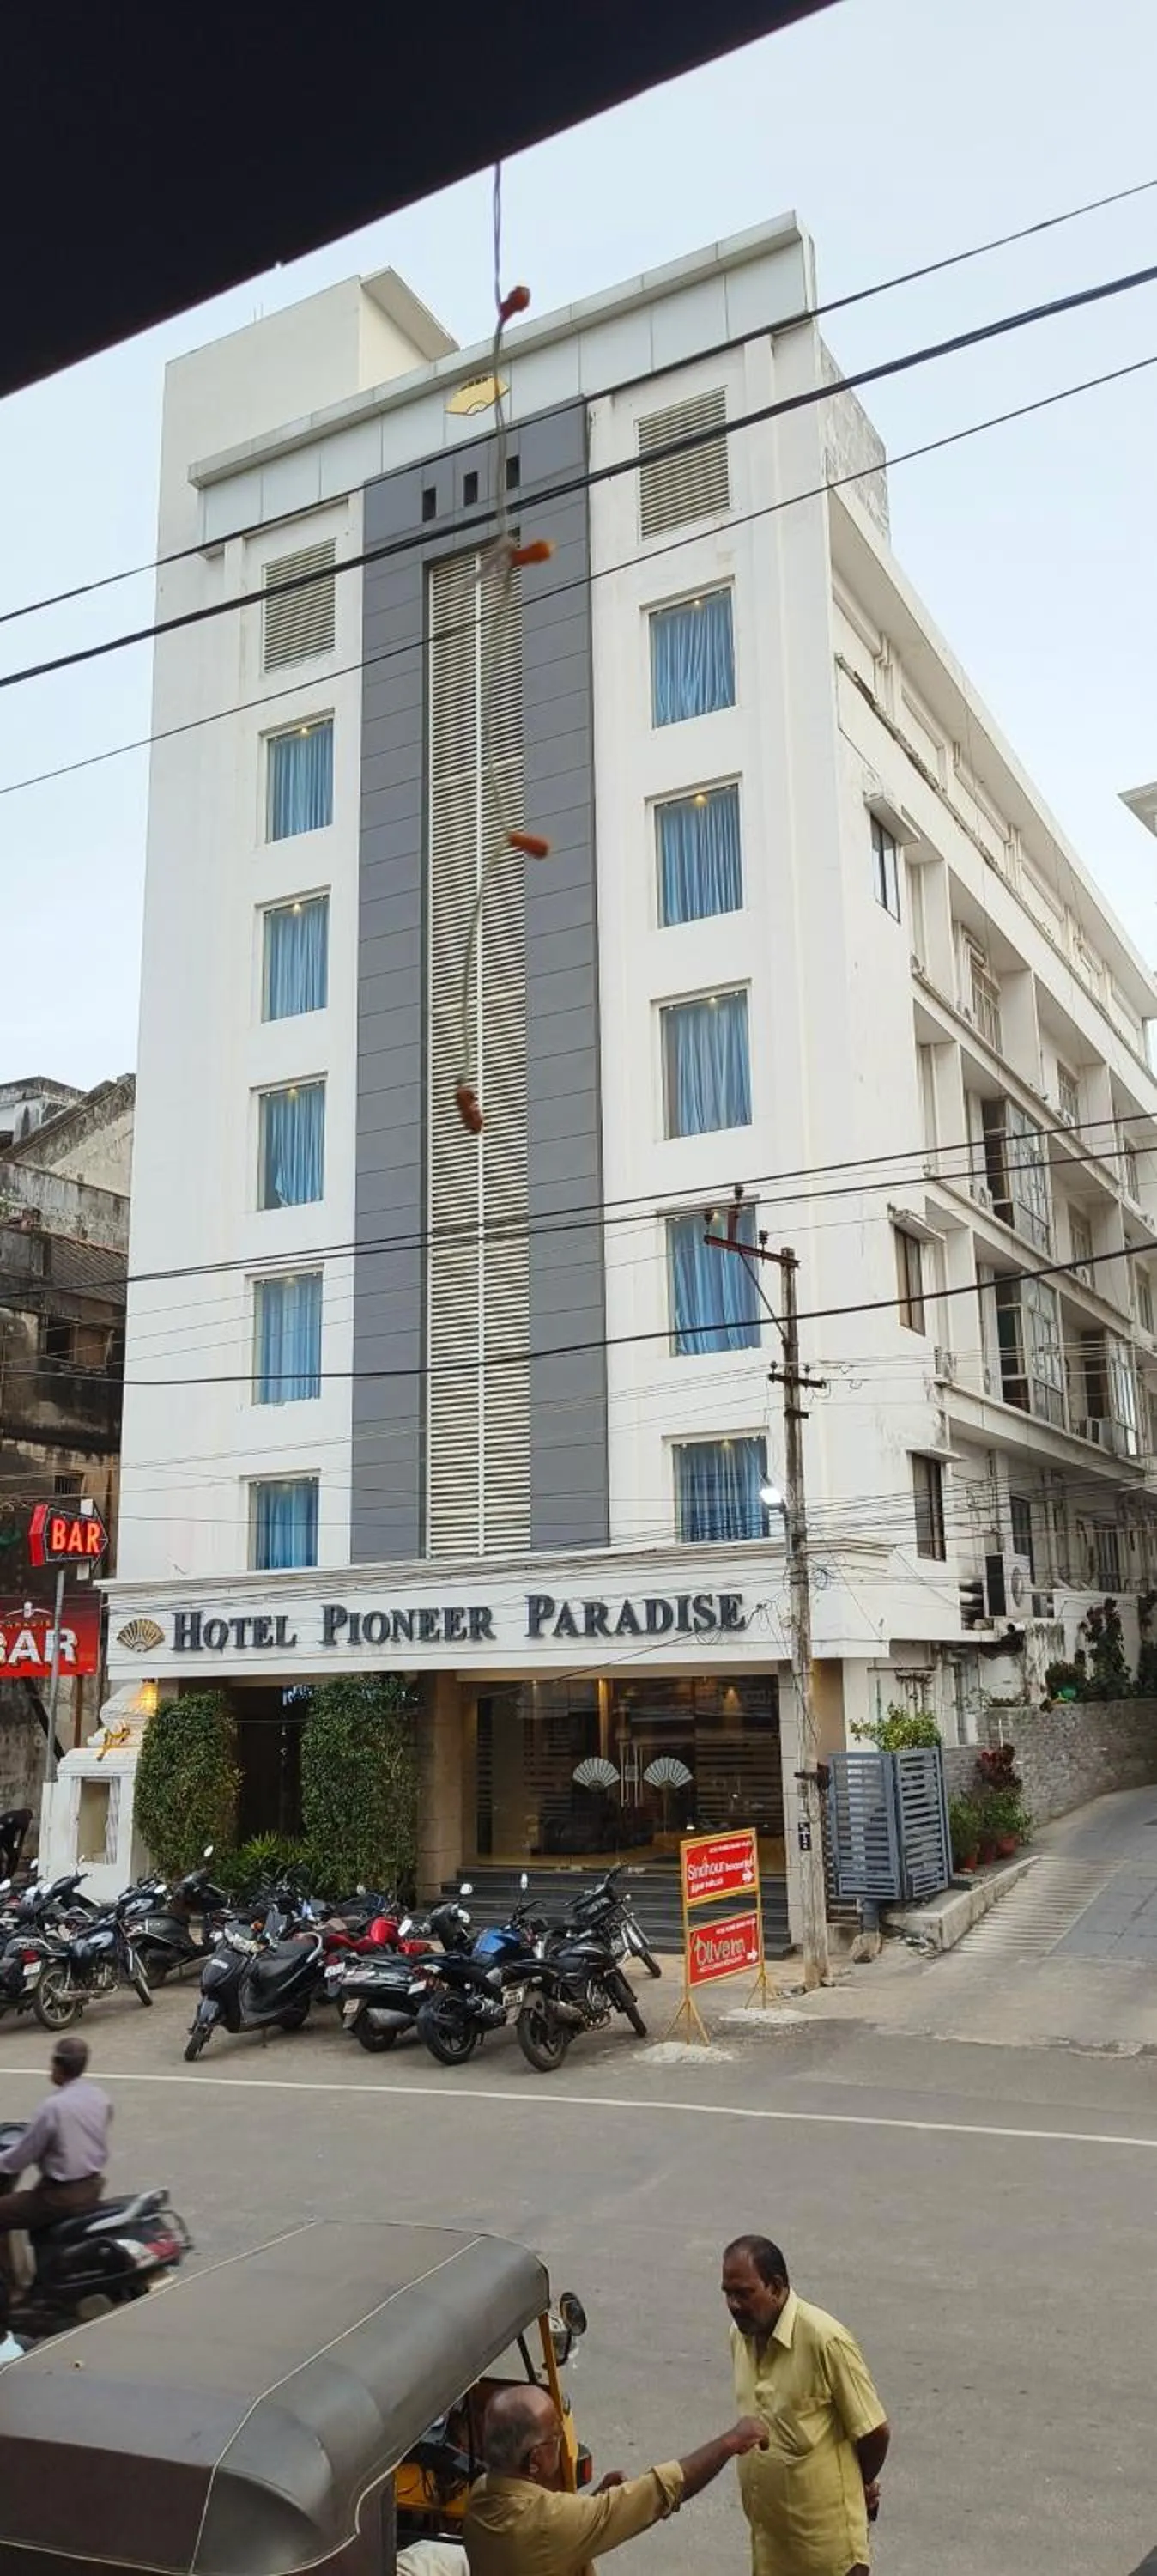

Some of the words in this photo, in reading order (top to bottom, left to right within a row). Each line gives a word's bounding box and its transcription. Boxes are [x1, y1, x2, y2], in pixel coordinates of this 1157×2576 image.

[52, 1518, 100, 1553] BAR
[173, 1611, 296, 1652] HOTEL
[321, 1603, 496, 1644] PIONEER
[525, 1593, 747, 1637] PARADISE
[0, 1628, 76, 1663] AR
